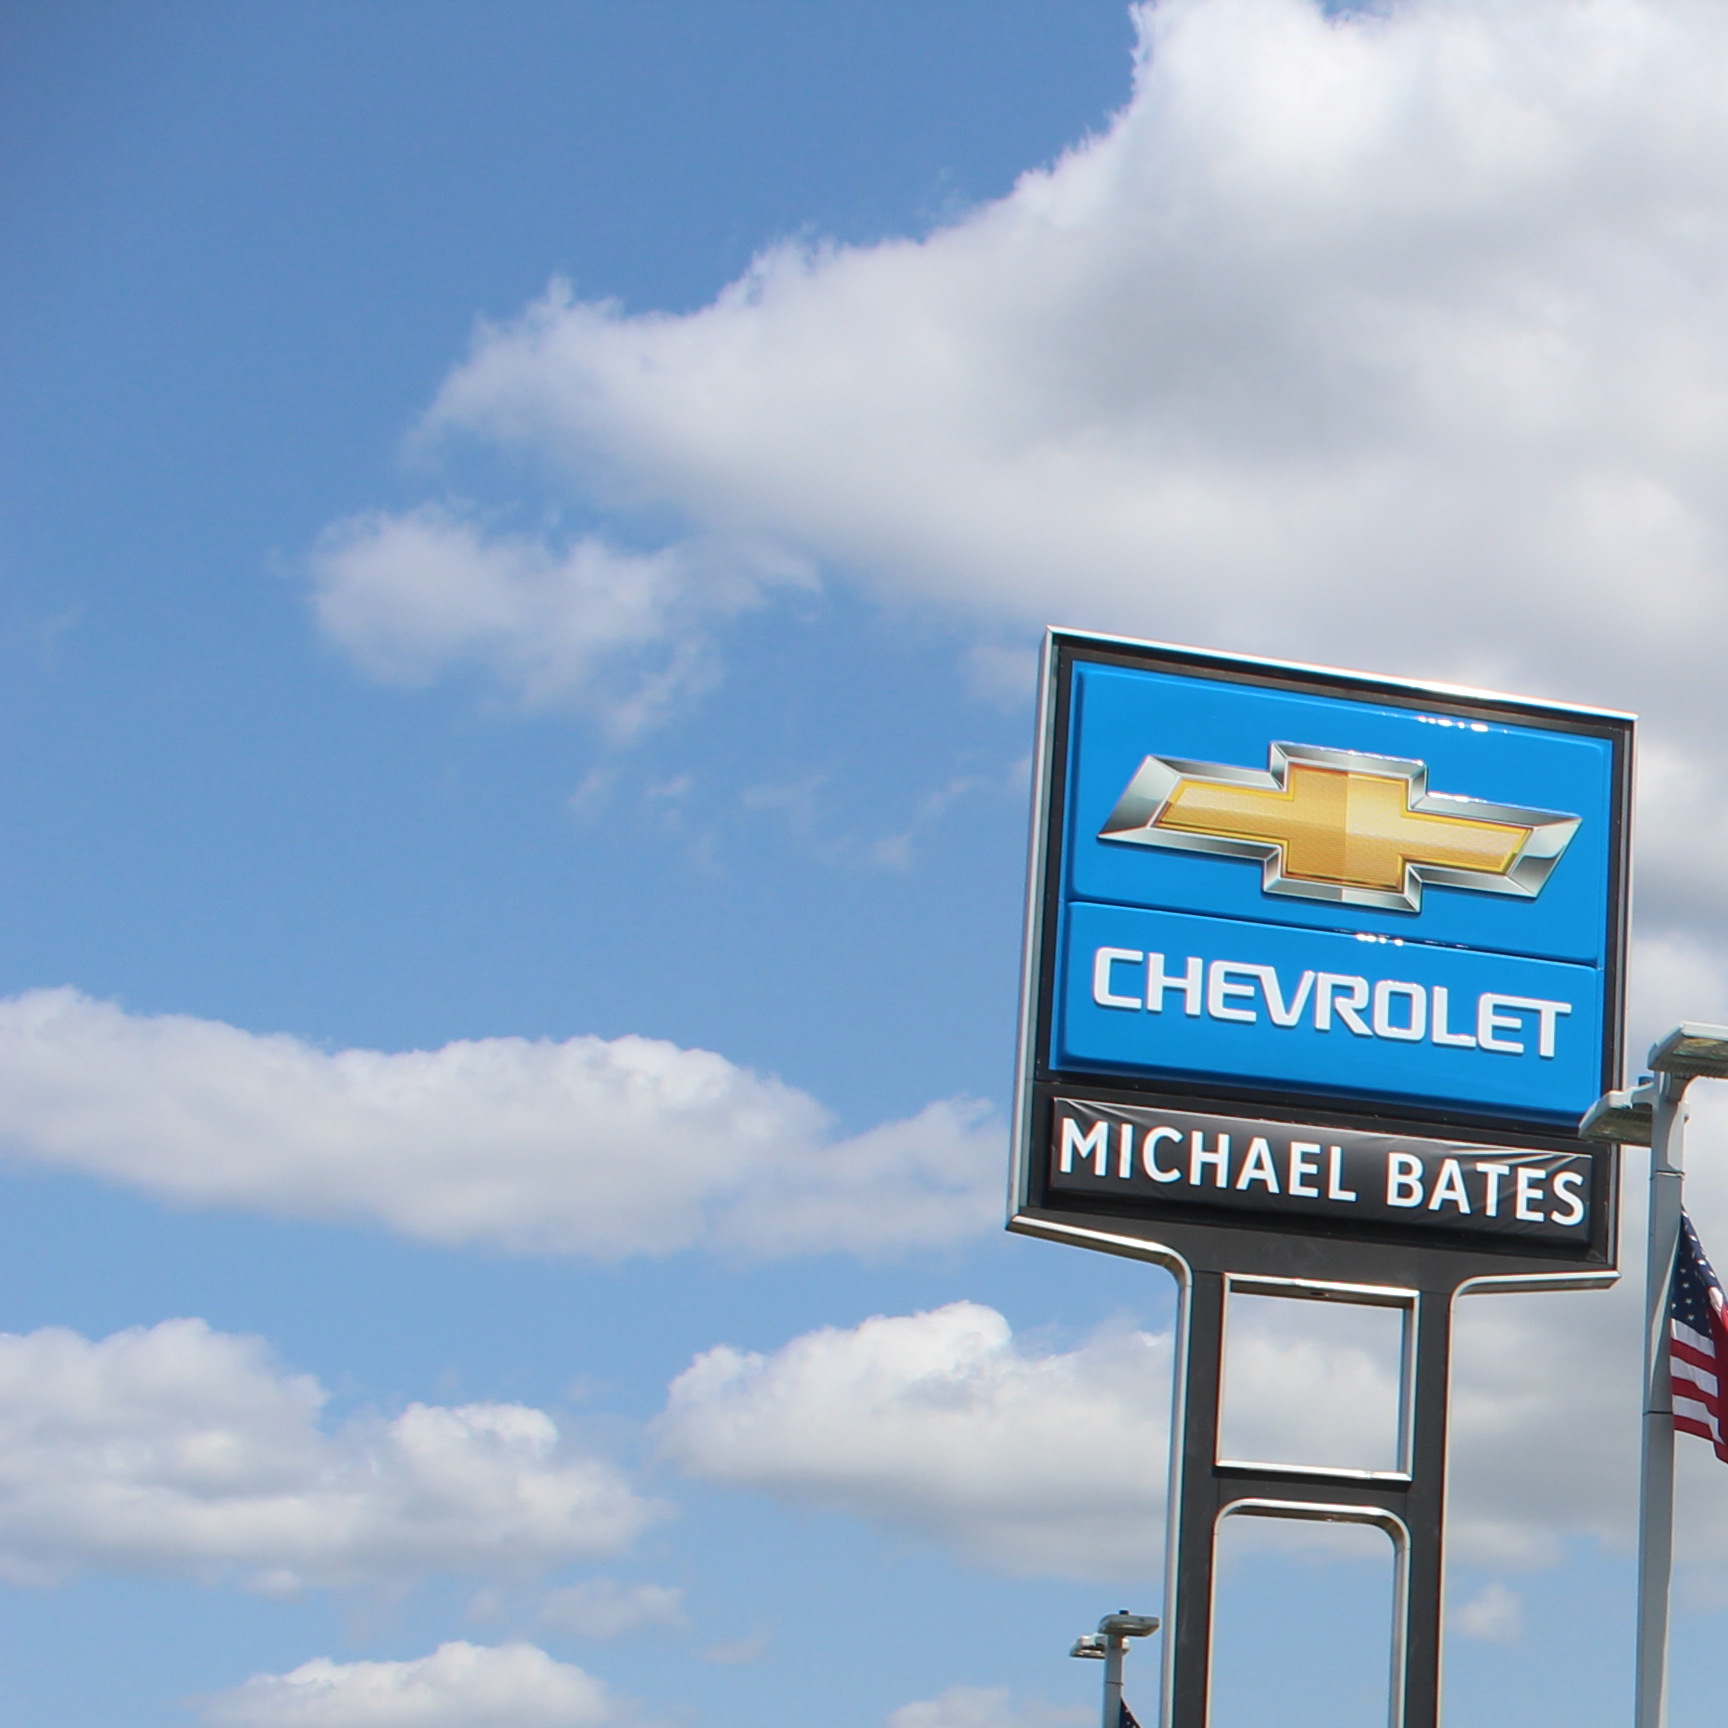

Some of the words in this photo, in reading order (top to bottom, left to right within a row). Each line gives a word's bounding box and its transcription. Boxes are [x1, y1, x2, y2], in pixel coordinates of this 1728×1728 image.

[1093, 946, 1572, 1058] CHEVROLET
[1058, 1116, 1357, 1202] MICHAEL
[1386, 1151, 1586, 1226] BATES
